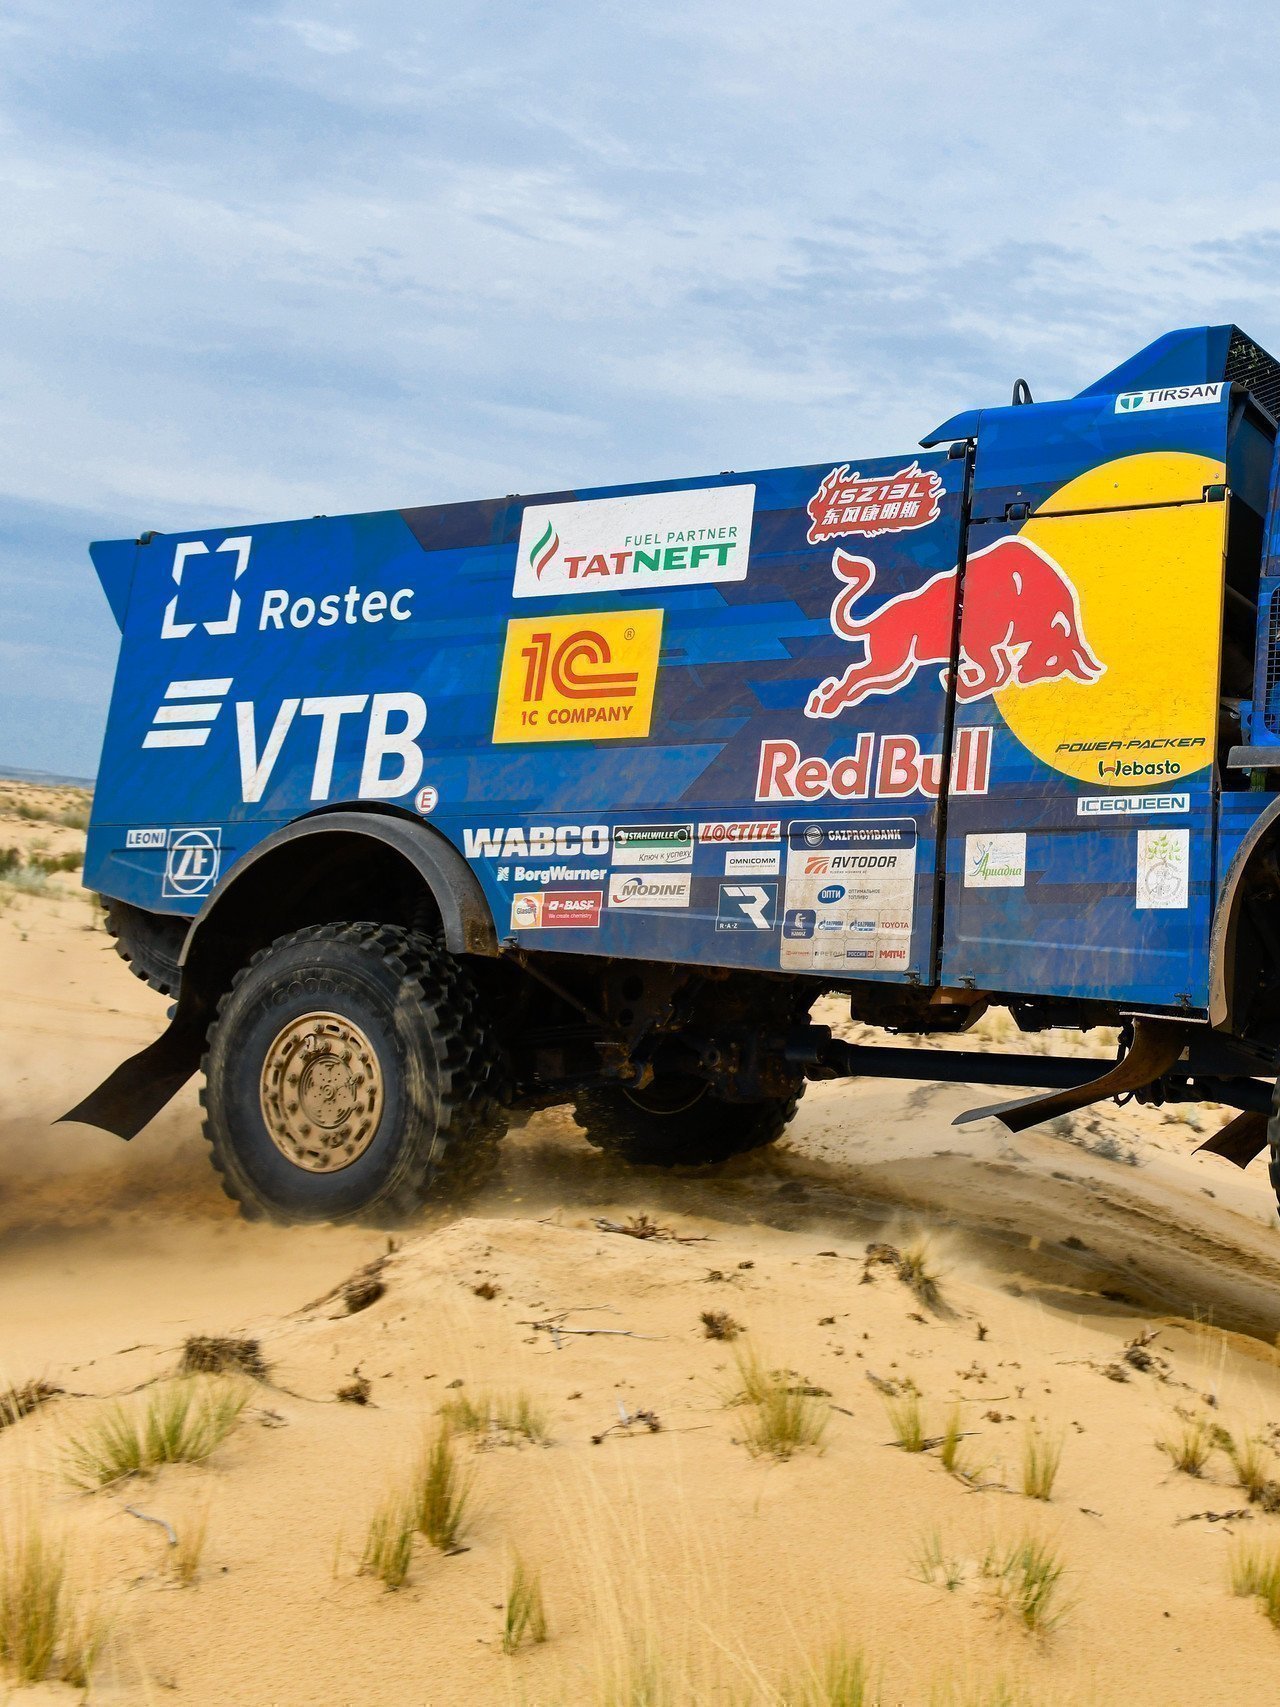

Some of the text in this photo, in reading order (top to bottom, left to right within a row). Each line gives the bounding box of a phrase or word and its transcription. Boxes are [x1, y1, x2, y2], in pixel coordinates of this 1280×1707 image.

[829, 482, 925, 505] ISZ13L
[821, 500, 921, 526] 东风康明斯
[625, 526, 738, 547] FUEL PARTNER
[564, 542, 736, 579] TATNEFT
[259, 585, 415, 631] Rostec
[521, 706, 633, 726] 1C COMPANY
[235, 692, 428, 803] VTB
[1055, 737, 1206, 753] POWER-PACKER
[757, 734, 873, 799] Red
[1098, 760, 1180, 778] Webasto
[421, 792, 433, 808] E
[1081, 797, 1185, 813] ICEQUEEN
[128, 832, 164, 845] LEONI
[463, 825, 609, 858] WABCO
[701, 823, 778, 842] LOCTITE
[828, 829, 902, 841] GAZPROMBANK
[174, 845, 216, 880] ZF
[832, 856, 897, 868] AVTODOR
[976, 853, 1022, 880] Ариадна
[515, 866, 607, 884] BorgWarner
[622, 884, 687, 896] MODINE
[821, 890, 841, 899] ОПТИ
[564, 900, 595, 910] BASF
[881, 921, 909, 929] TOYOTA
